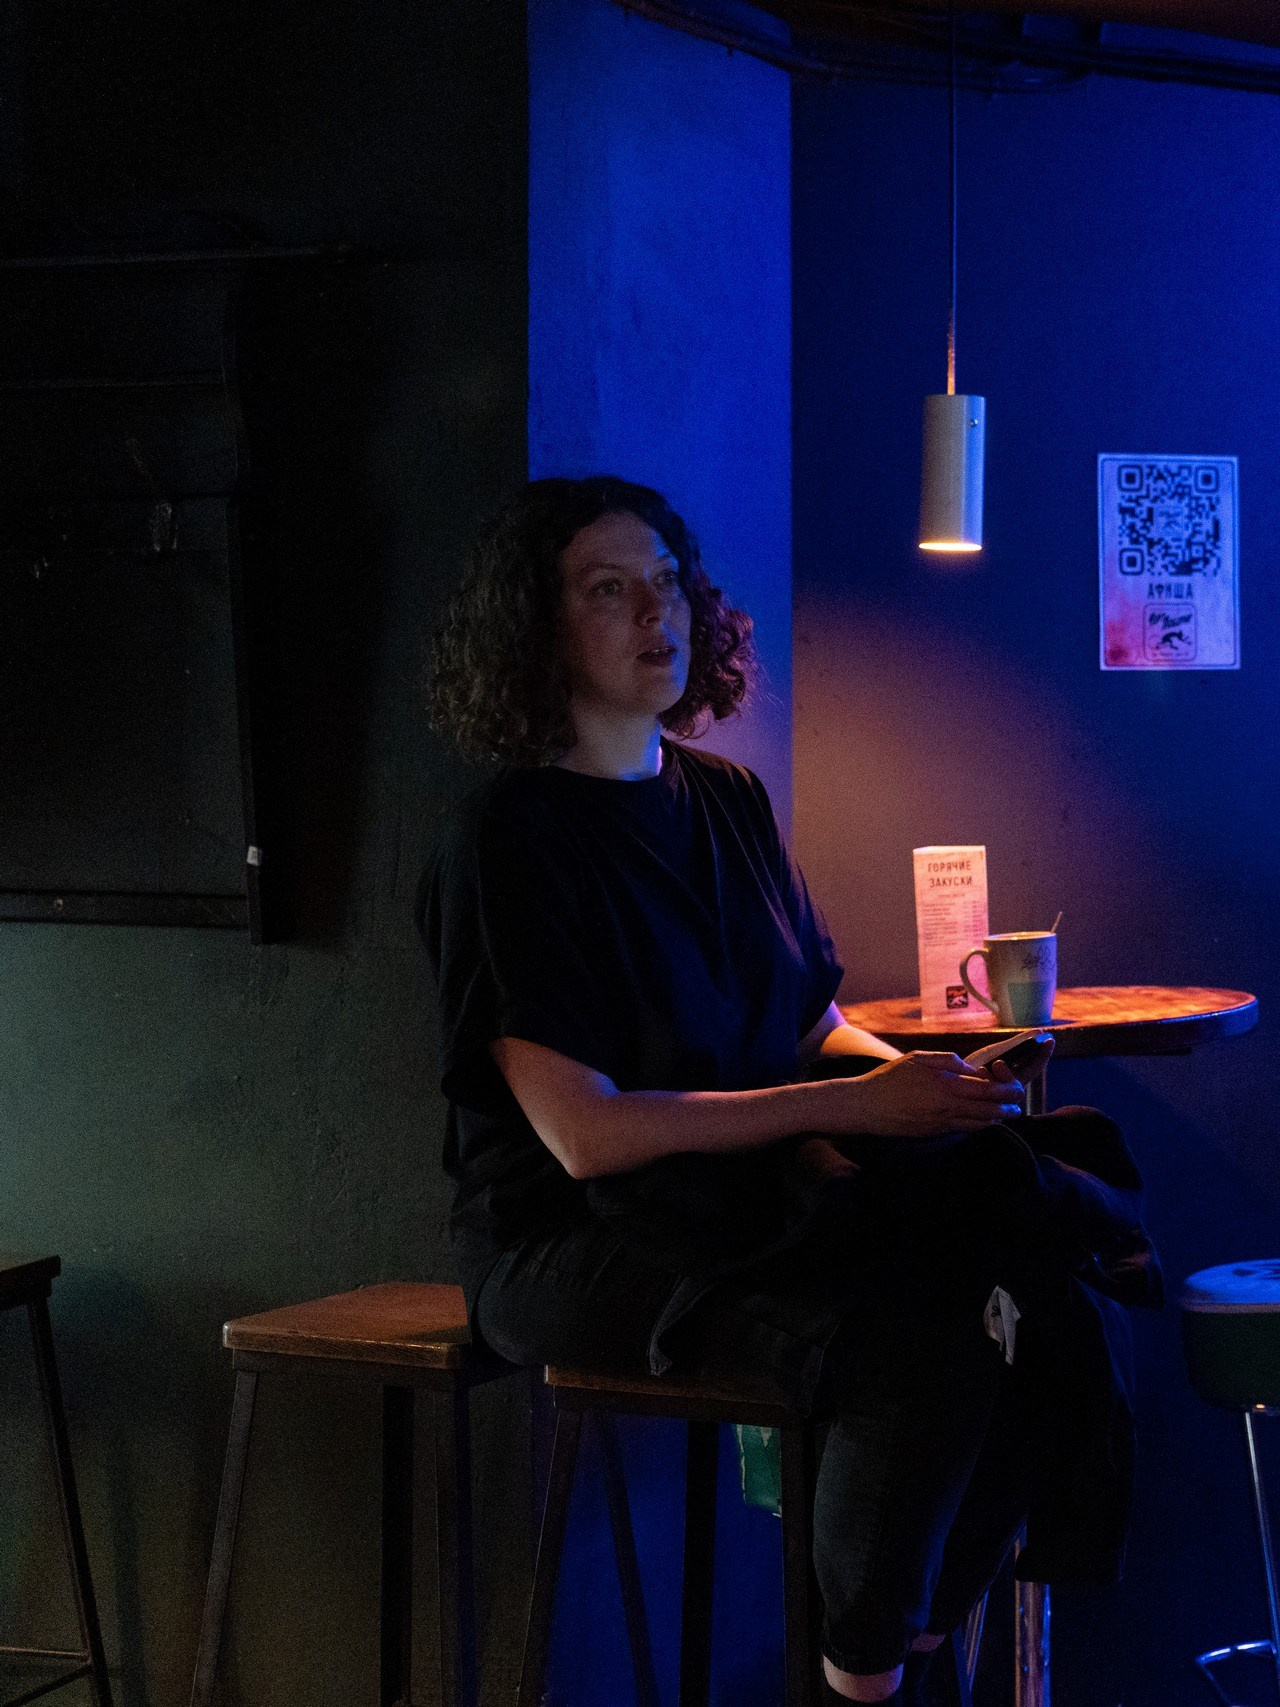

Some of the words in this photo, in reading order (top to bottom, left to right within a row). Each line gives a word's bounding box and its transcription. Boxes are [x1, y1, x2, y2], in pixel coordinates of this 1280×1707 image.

[1147, 583, 1194, 599] АФИША
[927, 860, 972, 873] ГОРЯЧИЕ
[928, 875, 973, 888] ЗАКУСКИ
